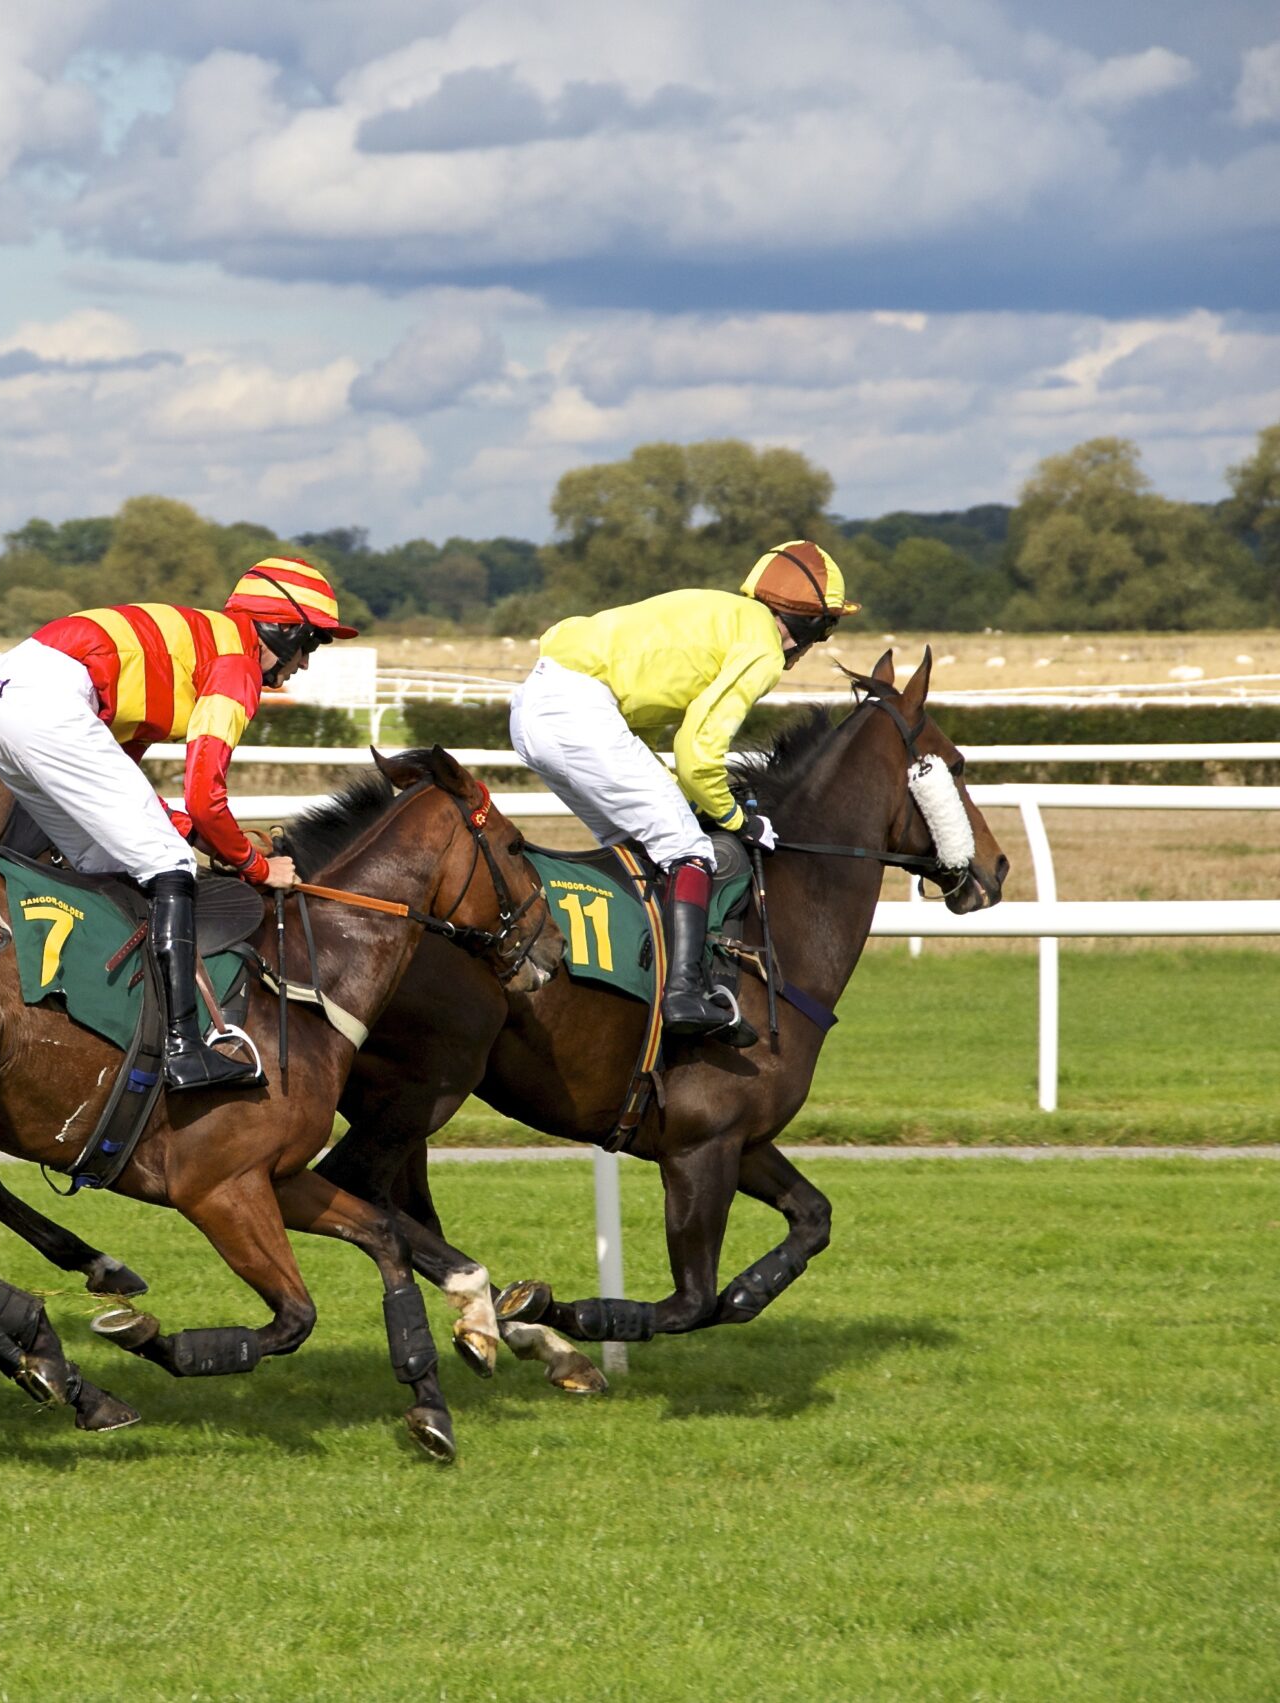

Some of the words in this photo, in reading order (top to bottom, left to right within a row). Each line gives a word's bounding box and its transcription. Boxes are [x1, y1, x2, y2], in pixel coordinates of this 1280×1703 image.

[20, 896, 84, 921] BANGOR-ON-DEE
[549, 880, 615, 899] BANGOR-ON-DEE
[23, 906, 74, 988] 7
[558, 892, 614, 972] 11
